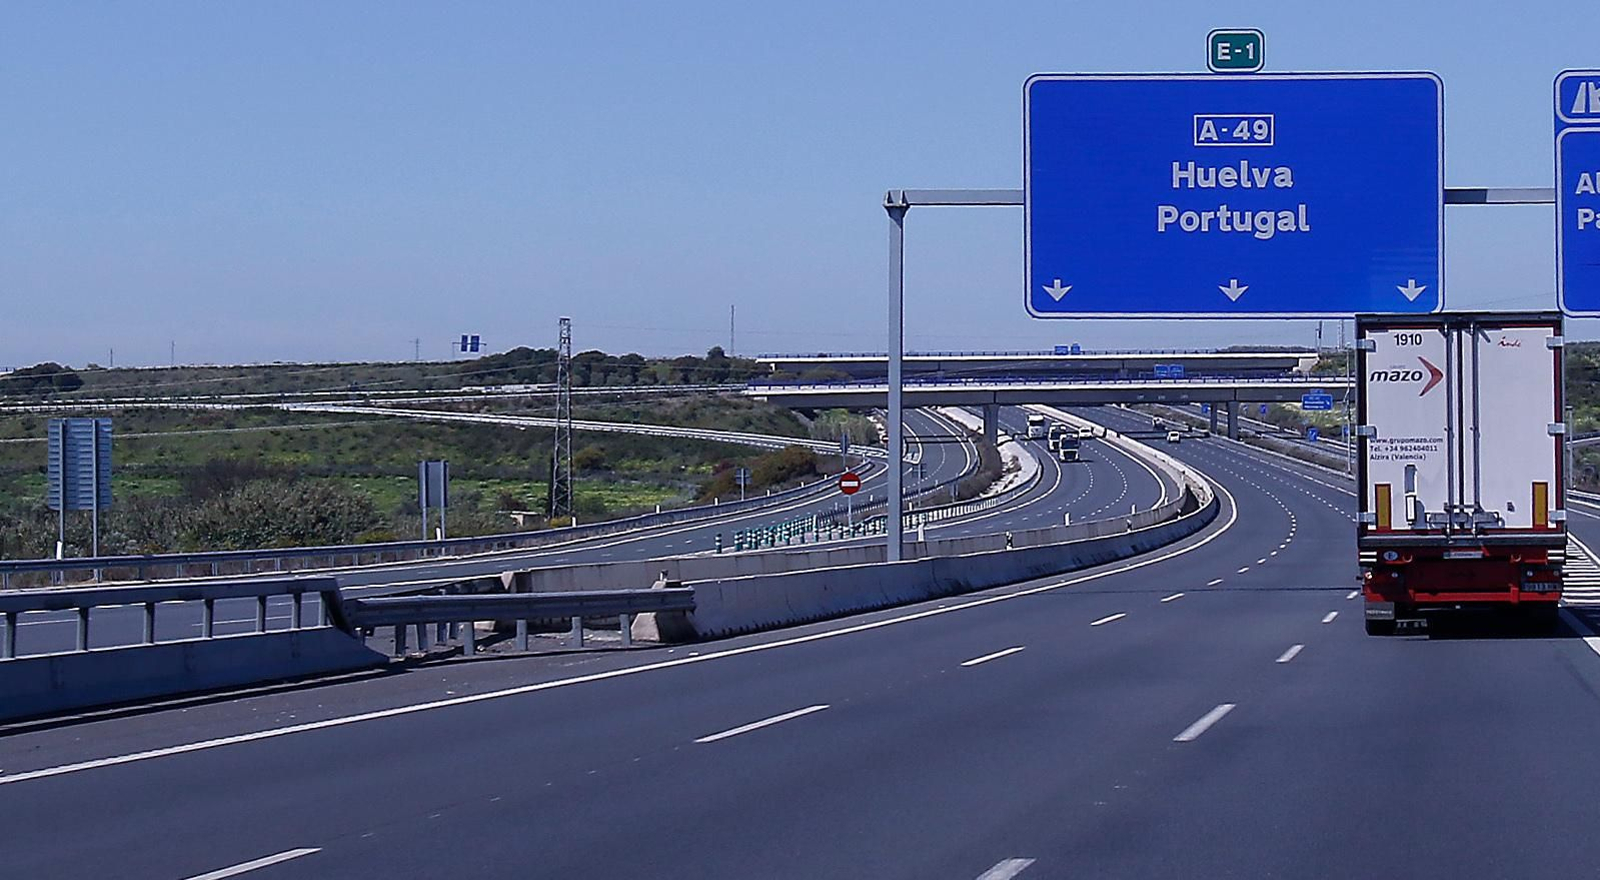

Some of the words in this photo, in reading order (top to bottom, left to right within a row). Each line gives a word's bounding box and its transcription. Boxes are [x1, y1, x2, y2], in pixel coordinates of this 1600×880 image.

[1172, 161, 1293, 188] Huelva
[1157, 204, 1310, 240] Portugal
[1394, 333, 1422, 346] 1910
[1369, 370, 1423, 381] mazo
[1391, 453, 1427, 461] (Valencia)
